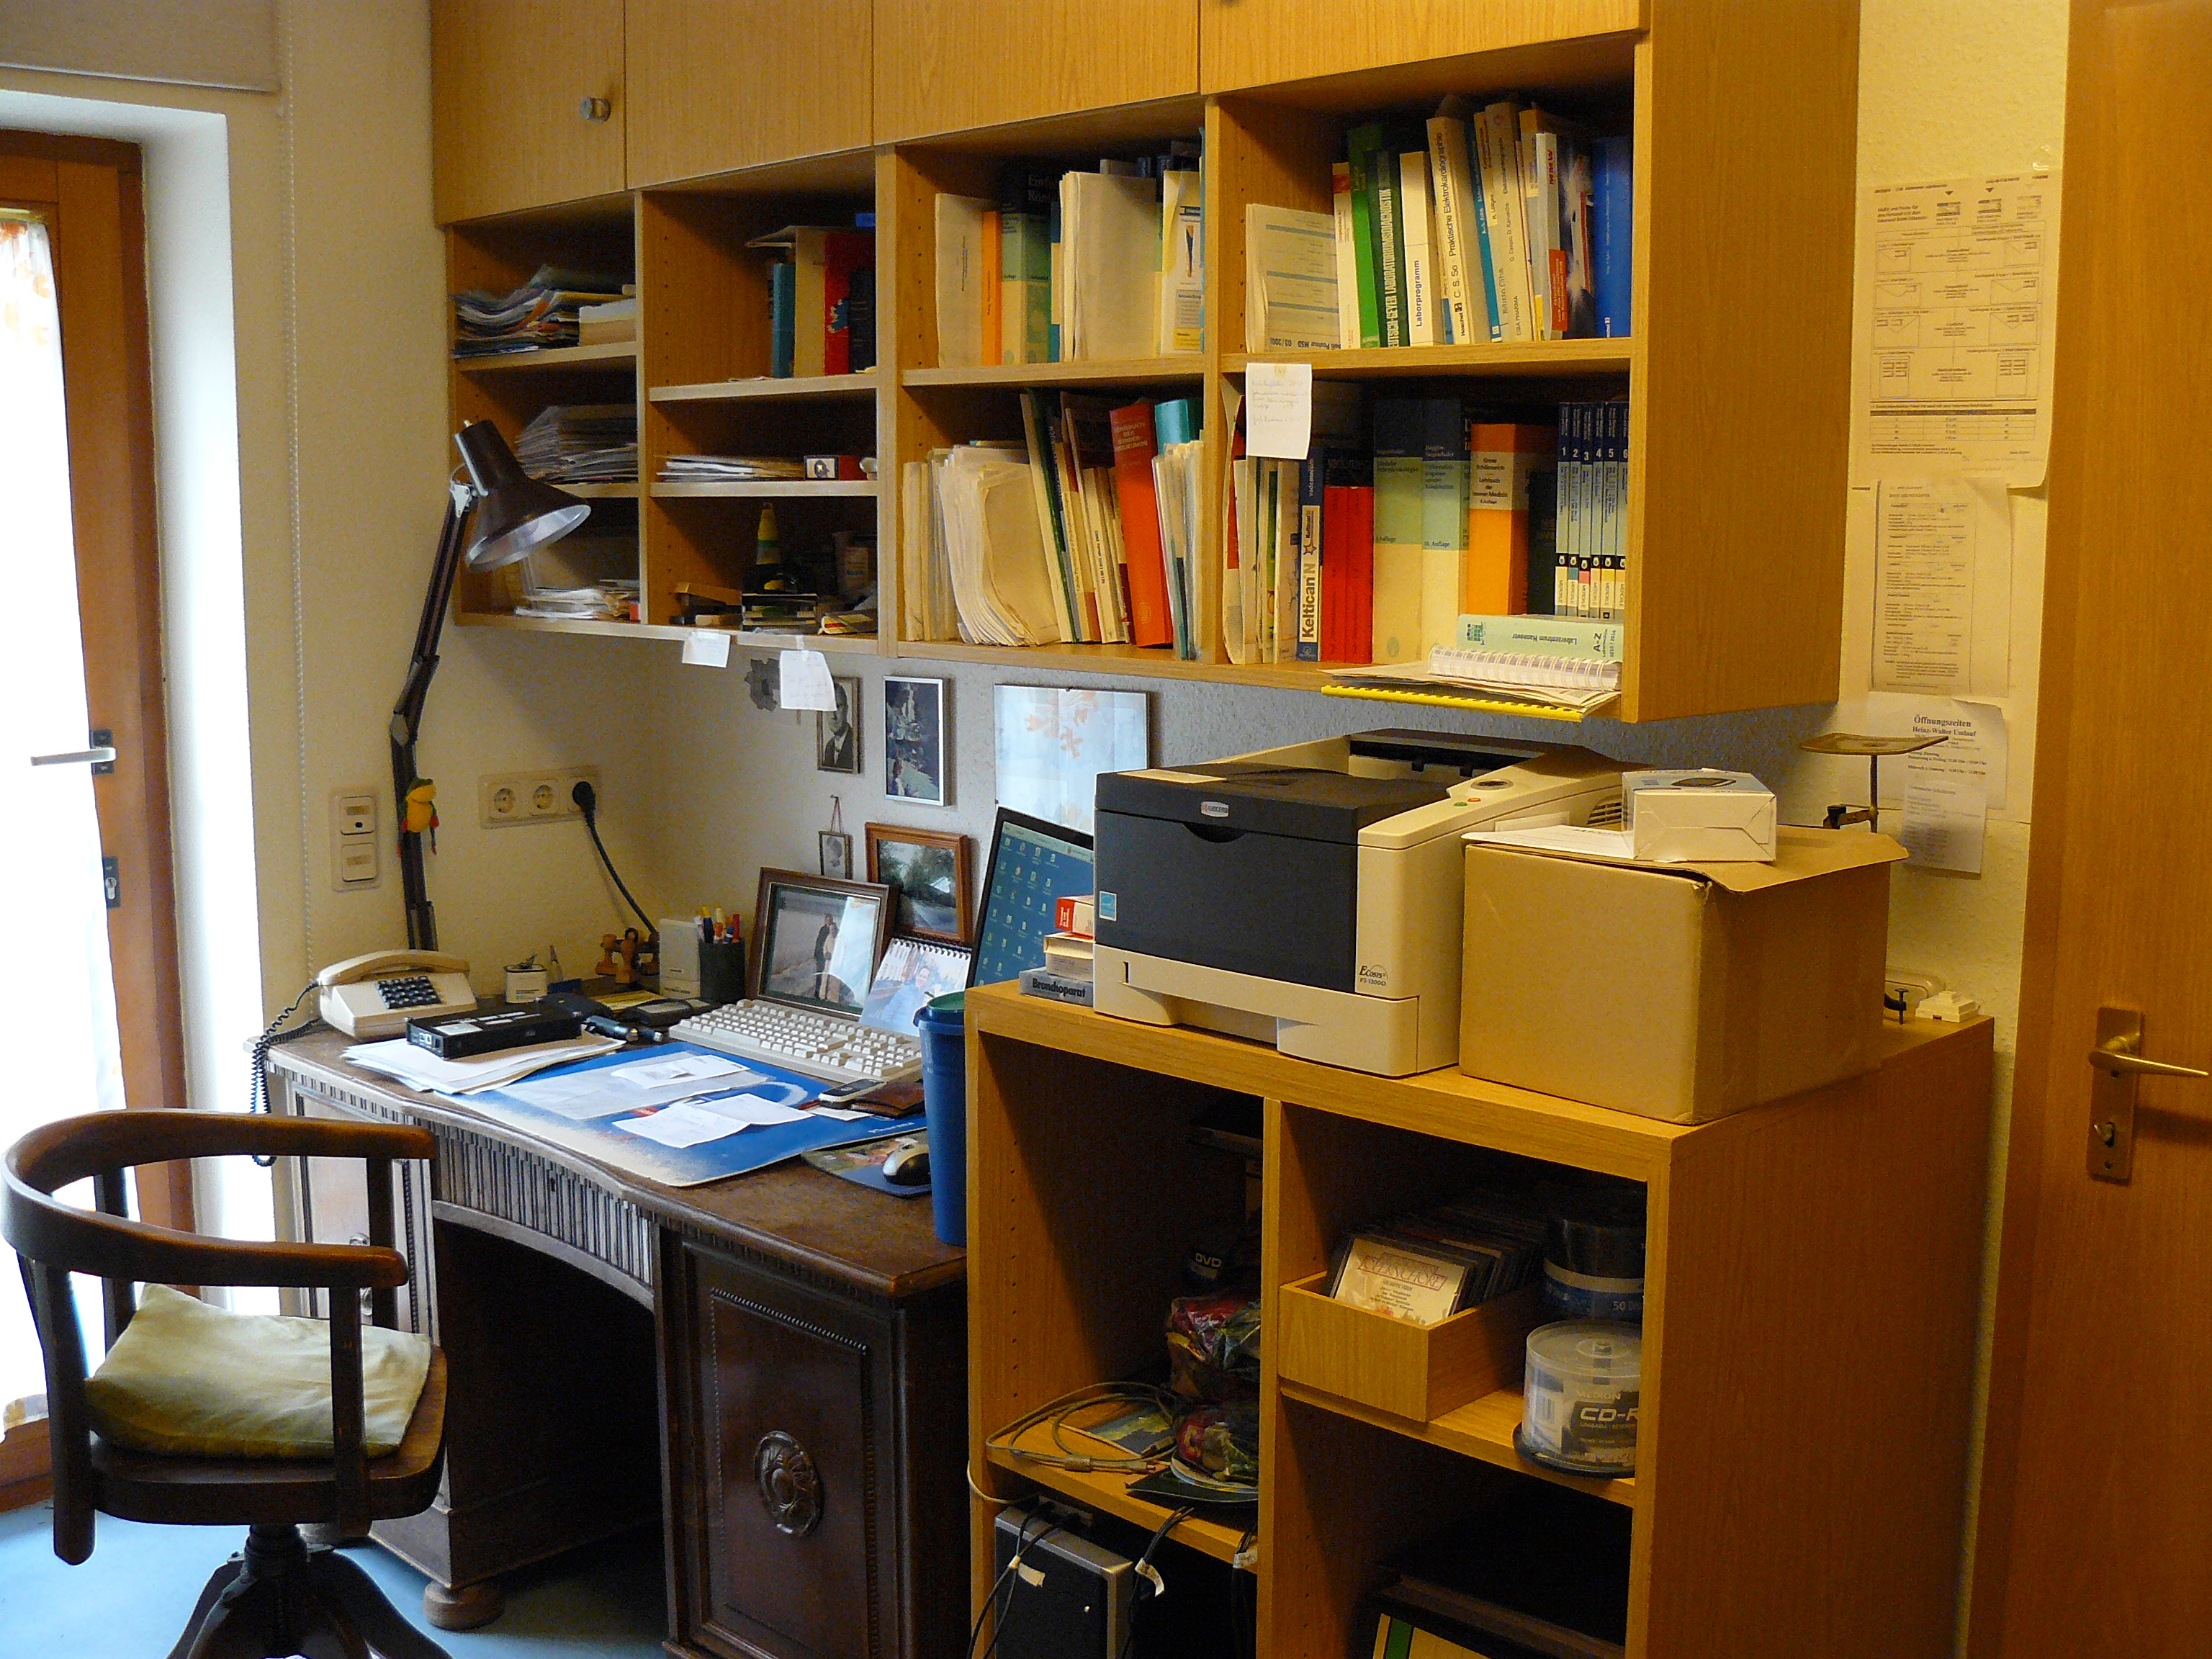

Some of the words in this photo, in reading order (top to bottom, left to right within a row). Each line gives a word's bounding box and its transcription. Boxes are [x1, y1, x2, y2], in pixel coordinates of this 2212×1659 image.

[1436, 132, 1452, 212] Elektrokardiographie
[1444, 212, 1456, 257] Praktische
[1413, 260, 1424, 328] Laborprogramm
[1561, 446, 1566, 456] 1
[1573, 448, 1579, 458] 2
[1583, 451, 1589, 461] 3
[1596, 447, 1602, 458] 4
[1608, 448, 1614, 458] 5
[1301, 575, 1316, 639] Keltican
[1593, 632, 1602, 652] A-Z
[1913, 714, 1972, 728] Öffnungszeiten
[1033, 978, 1086, 998] Bronchoparat
[1195, 1253, 1222, 1267] DVD
[1613, 1300, 1626, 1310] 50
